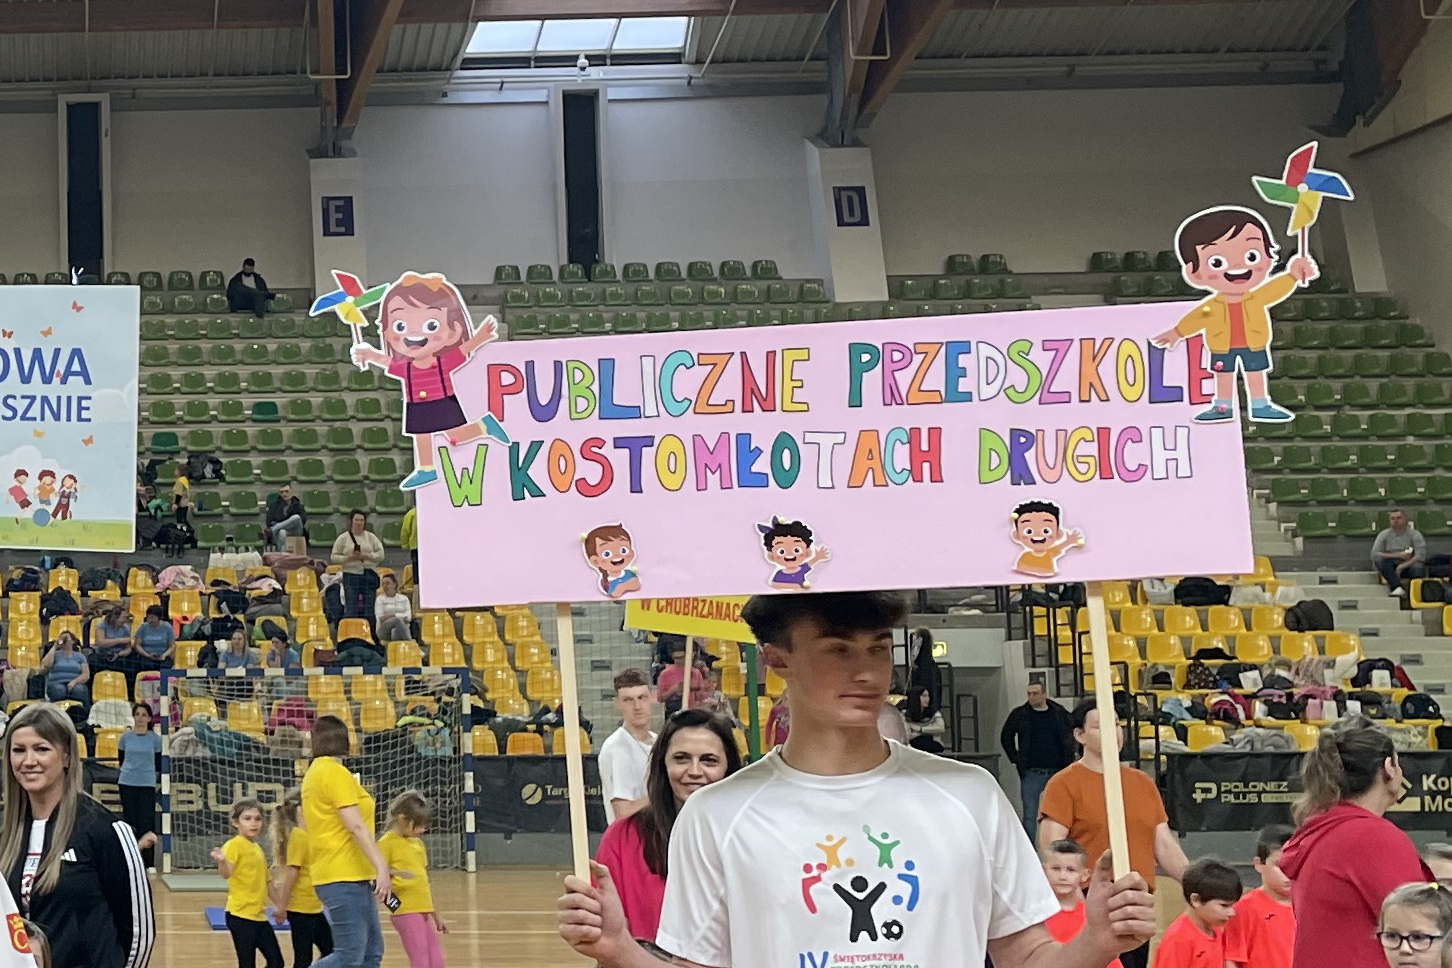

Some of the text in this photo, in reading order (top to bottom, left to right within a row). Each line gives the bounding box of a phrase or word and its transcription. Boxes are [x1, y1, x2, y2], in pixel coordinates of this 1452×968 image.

[328, 200, 346, 233] E
[841, 190, 862, 223] D
[487, 347, 811, 423] PUBLICZNE
[438, 425, 1194, 508] W KOSTOMŁOTACH DRUGICH
[655, 597, 745, 623] CHOBRZANAC
[1220, 781, 1289, 792] POLONEZ
[1220, 793, 1259, 804] PLUS
[832, 952, 905, 965] ŚWIĘTOKRZYSKA
